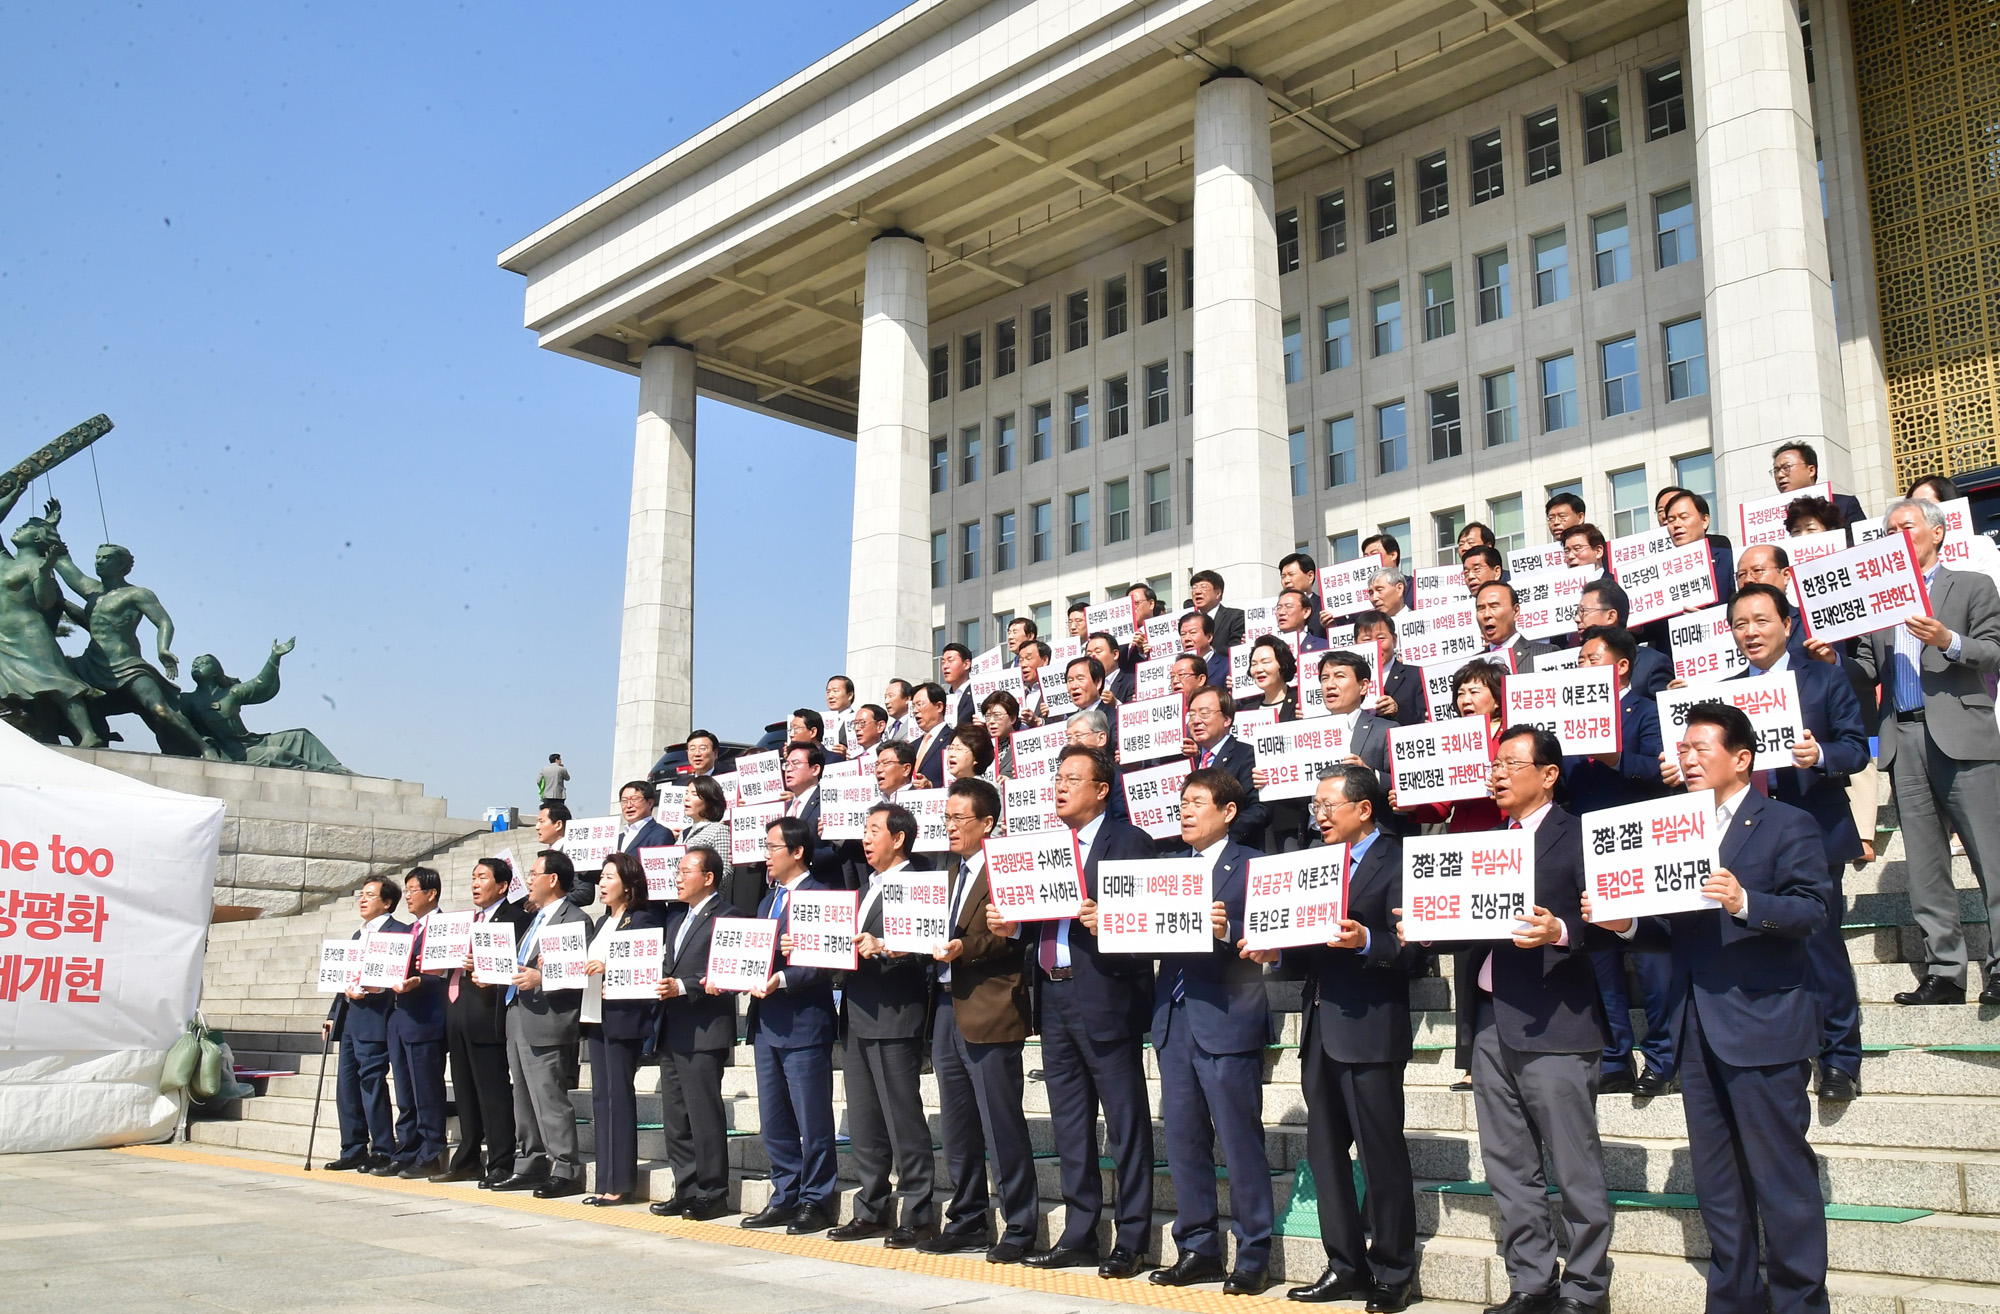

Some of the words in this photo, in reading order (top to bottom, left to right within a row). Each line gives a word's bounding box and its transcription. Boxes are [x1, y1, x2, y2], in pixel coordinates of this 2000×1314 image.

[1748, 504, 1788, 526] 국정원댓글
[1512, 553, 1543, 573] 민주당의
[1614, 543, 1645, 563] 댓글공작
[1622, 564, 1659, 589] 민주당의
[1662, 550, 1704, 577] 댓글공작
[1802, 567, 1852, 598] 헌정유린
[1855, 550, 1907, 581] 국회사찰
[1323, 572, 1350, 590] 댓글공작
[1669, 574, 1712, 601] 일벌백계
[1326, 592, 1353, 609] 특검으로
[1811, 596, 1867, 630] 문재인정권
[1868, 582, 1917, 615] 규탄한다
[1088, 608, 1108, 625] 민주당의
[1108, 603, 1131, 620] 댓글공작
[1432, 615, 1456, 630] 18억원
[1457, 610, 1472, 627] 증발
[1517, 610, 1548, 629] 특검으로
[1148, 622, 1170, 638] 민주당의
[1405, 643, 1437, 662] 특검으로
[1441, 635, 1475, 656] 규명하라
[1140, 666, 1165, 683] 민주당의
[1675, 653, 1719, 679] 특검으로
[973, 681, 996, 696] 댓글공작
[1511, 688, 1556, 710] 댓글공작
[1562, 683, 1610, 706] 여론조작
[1733, 687, 1787, 715] 부실수사
[1122, 710, 1149, 728] 청와대의
[1152, 703, 1180, 722] 인사참사
[1294, 731, 1321, 750] 18억원
[1324, 728, 1342, 748] 증발
[1564, 717, 1611, 740] 진상규명
[1016, 737, 1042, 755] 민주당의
[1124, 734, 1151, 752] 대통령은
[1153, 728, 1181, 745] 사과하라
[1395, 738, 1436, 760] 헌정유린
[1441, 731, 1483, 754] 국회사찰
[1017, 760, 1045, 779] 진상규명
[1399, 768, 1445, 791] 문재인정권
[1448, 762, 1487, 785] 규탄한다
[1008, 789, 1036, 807] 헌정유린
[1128, 780, 1159, 801] 댓글공작
[734, 816, 757, 831] 헌정유린
[1009, 815, 1041, 832] 문재인정권
[1134, 808, 1164, 827] 특검으로
[1652, 811, 1705, 846] 부실수사
[48, 834, 114, 877] too
[991, 851, 1034, 874] 국정원댓글
[1037, 847, 1073, 871] 수사하듯
[1471, 848, 1522, 876] 부실수사
[1146, 874, 1178, 896] 18억원
[1182, 873, 1203, 896] 증발
[1252, 871, 1293, 897] 댓글공작
[1297, 863, 1340, 891] 여론조작
[1597, 868, 1645, 900] 특검으로
[1654, 858, 1711, 893] 진상규명
[932, 885, 946, 904] 증발
[996, 884, 1035, 906] 댓글공작
[1039, 881, 1079, 904] 수사하라
[792, 904, 820, 922] 댓글공작
[1249, 908, 1290, 933] 특검으로
[1296, 900, 1338, 928] 일벌백계
[1412, 895, 1460, 922] 특검으로
[1471, 892, 1525, 920] 진상규명
[428, 924, 447, 938] 헌정유린
[884, 917, 911, 935] 특검으로
[916, 918, 946, 938] 규명하라
[1103, 913, 1148, 934] 특검으로
[1155, 912, 1203, 934] 규명하라
[609, 941, 630, 958] 증거인멸
[716, 930, 742, 947] 댓글공작
[793, 934, 820, 951] 특검으로
[824, 934, 853, 954] 규명하라
[543, 963, 562, 979] 대통령은
[634, 968, 658, 985] 분노한다
[712, 958, 737, 974] 특검으로
[740, 959, 768, 978] 규명하라
